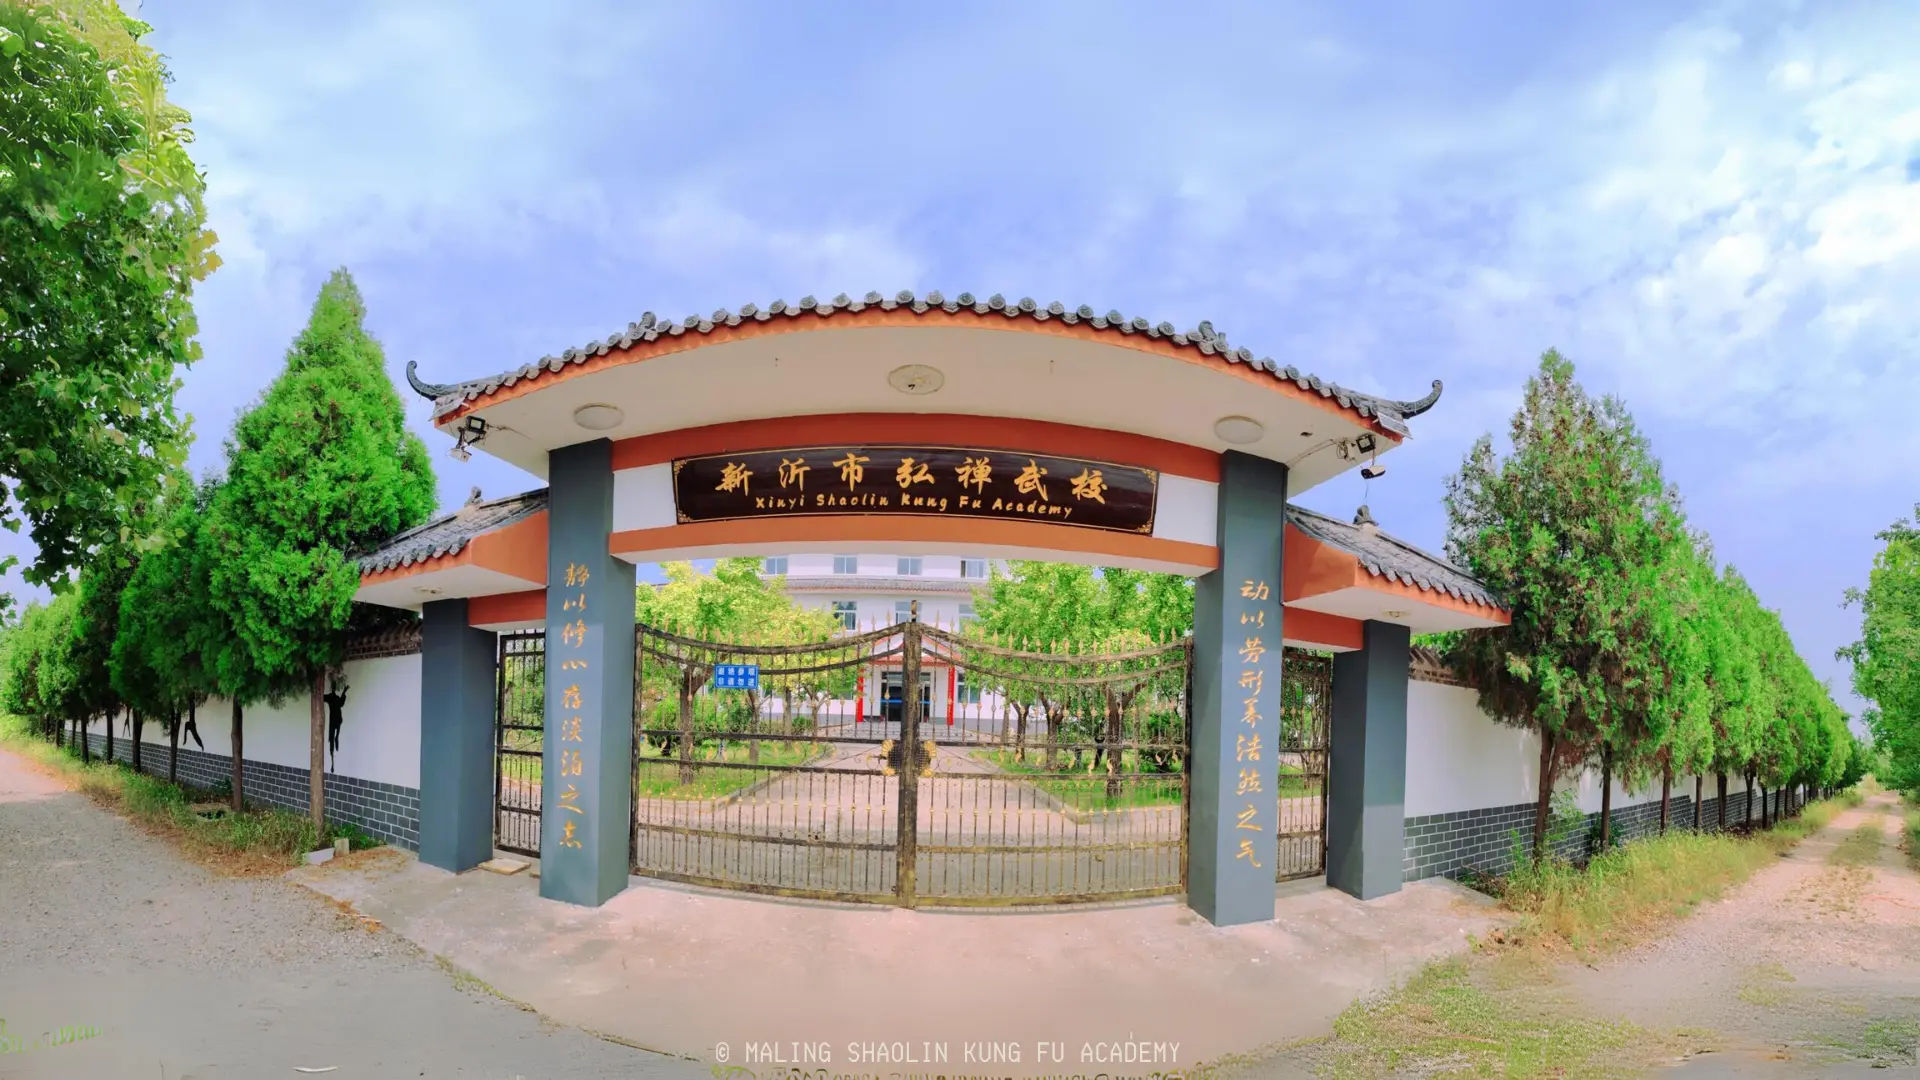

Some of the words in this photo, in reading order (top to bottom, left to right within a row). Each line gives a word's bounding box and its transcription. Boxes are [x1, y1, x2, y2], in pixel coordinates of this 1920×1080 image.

[755, 494, 805, 510] Xinyi
[816, 493, 889, 507] Shaolin
[901, 492, 948, 511] Kung
[959, 495, 982, 510] Fu
[992, 498, 1073, 519] Academy
